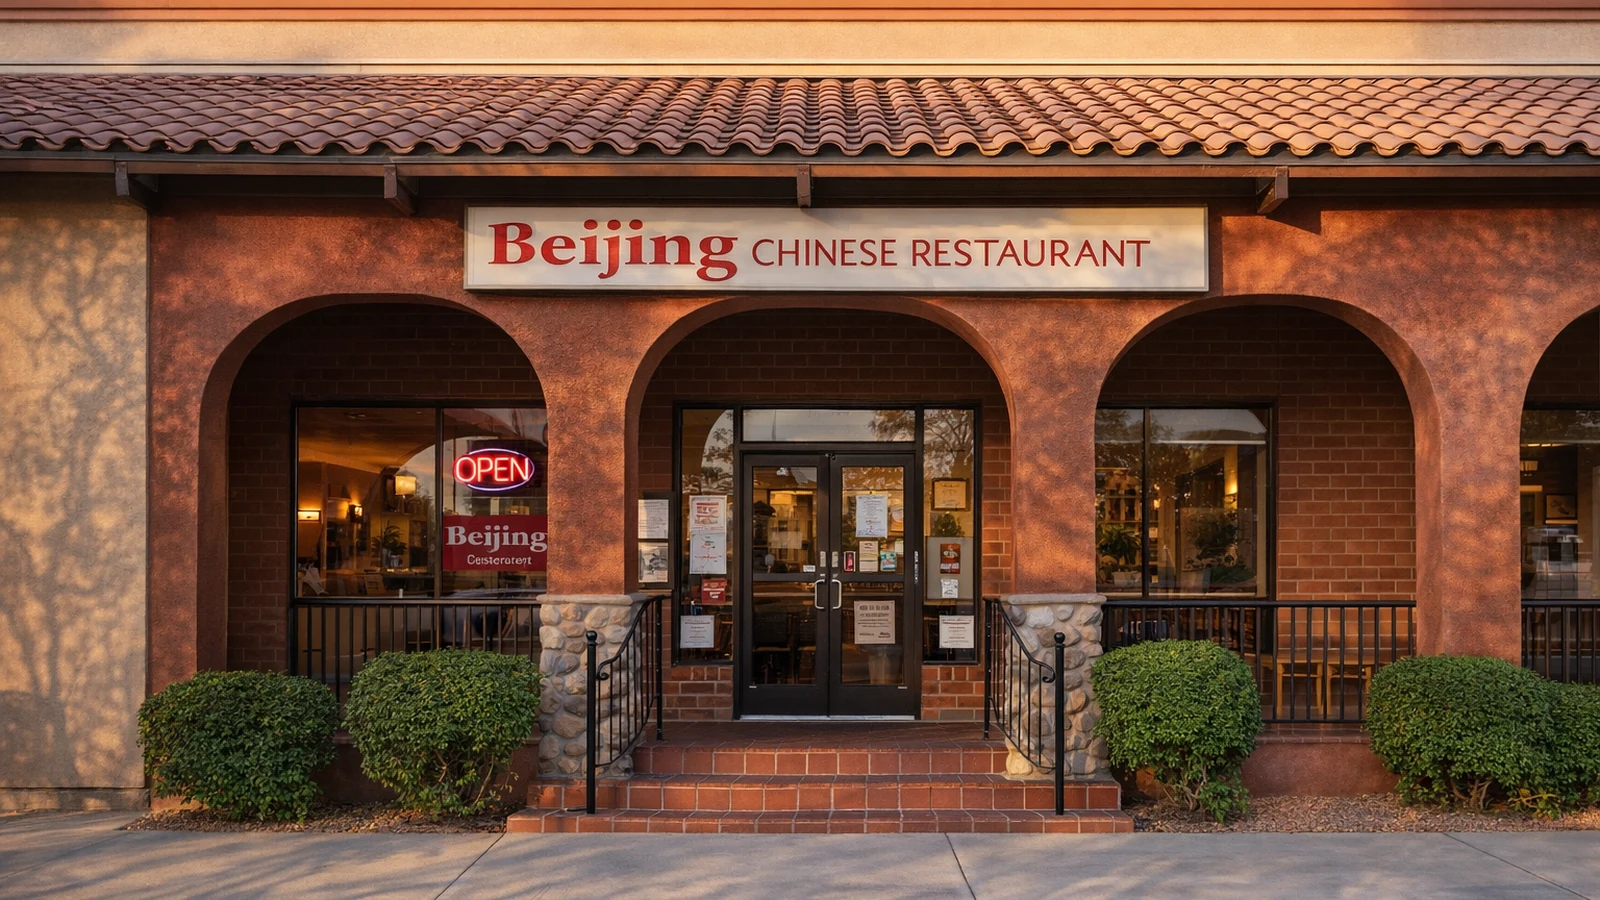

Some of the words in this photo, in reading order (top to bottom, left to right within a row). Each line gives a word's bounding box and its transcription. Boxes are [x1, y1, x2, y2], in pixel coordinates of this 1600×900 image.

[488, 219, 738, 282] Beijing
[752, 238, 897, 266] CHINESE
[911, 238, 1151, 267] RESTAURANT
[455, 456, 529, 482] OPEN
[445, 524, 548, 553] Beijing
